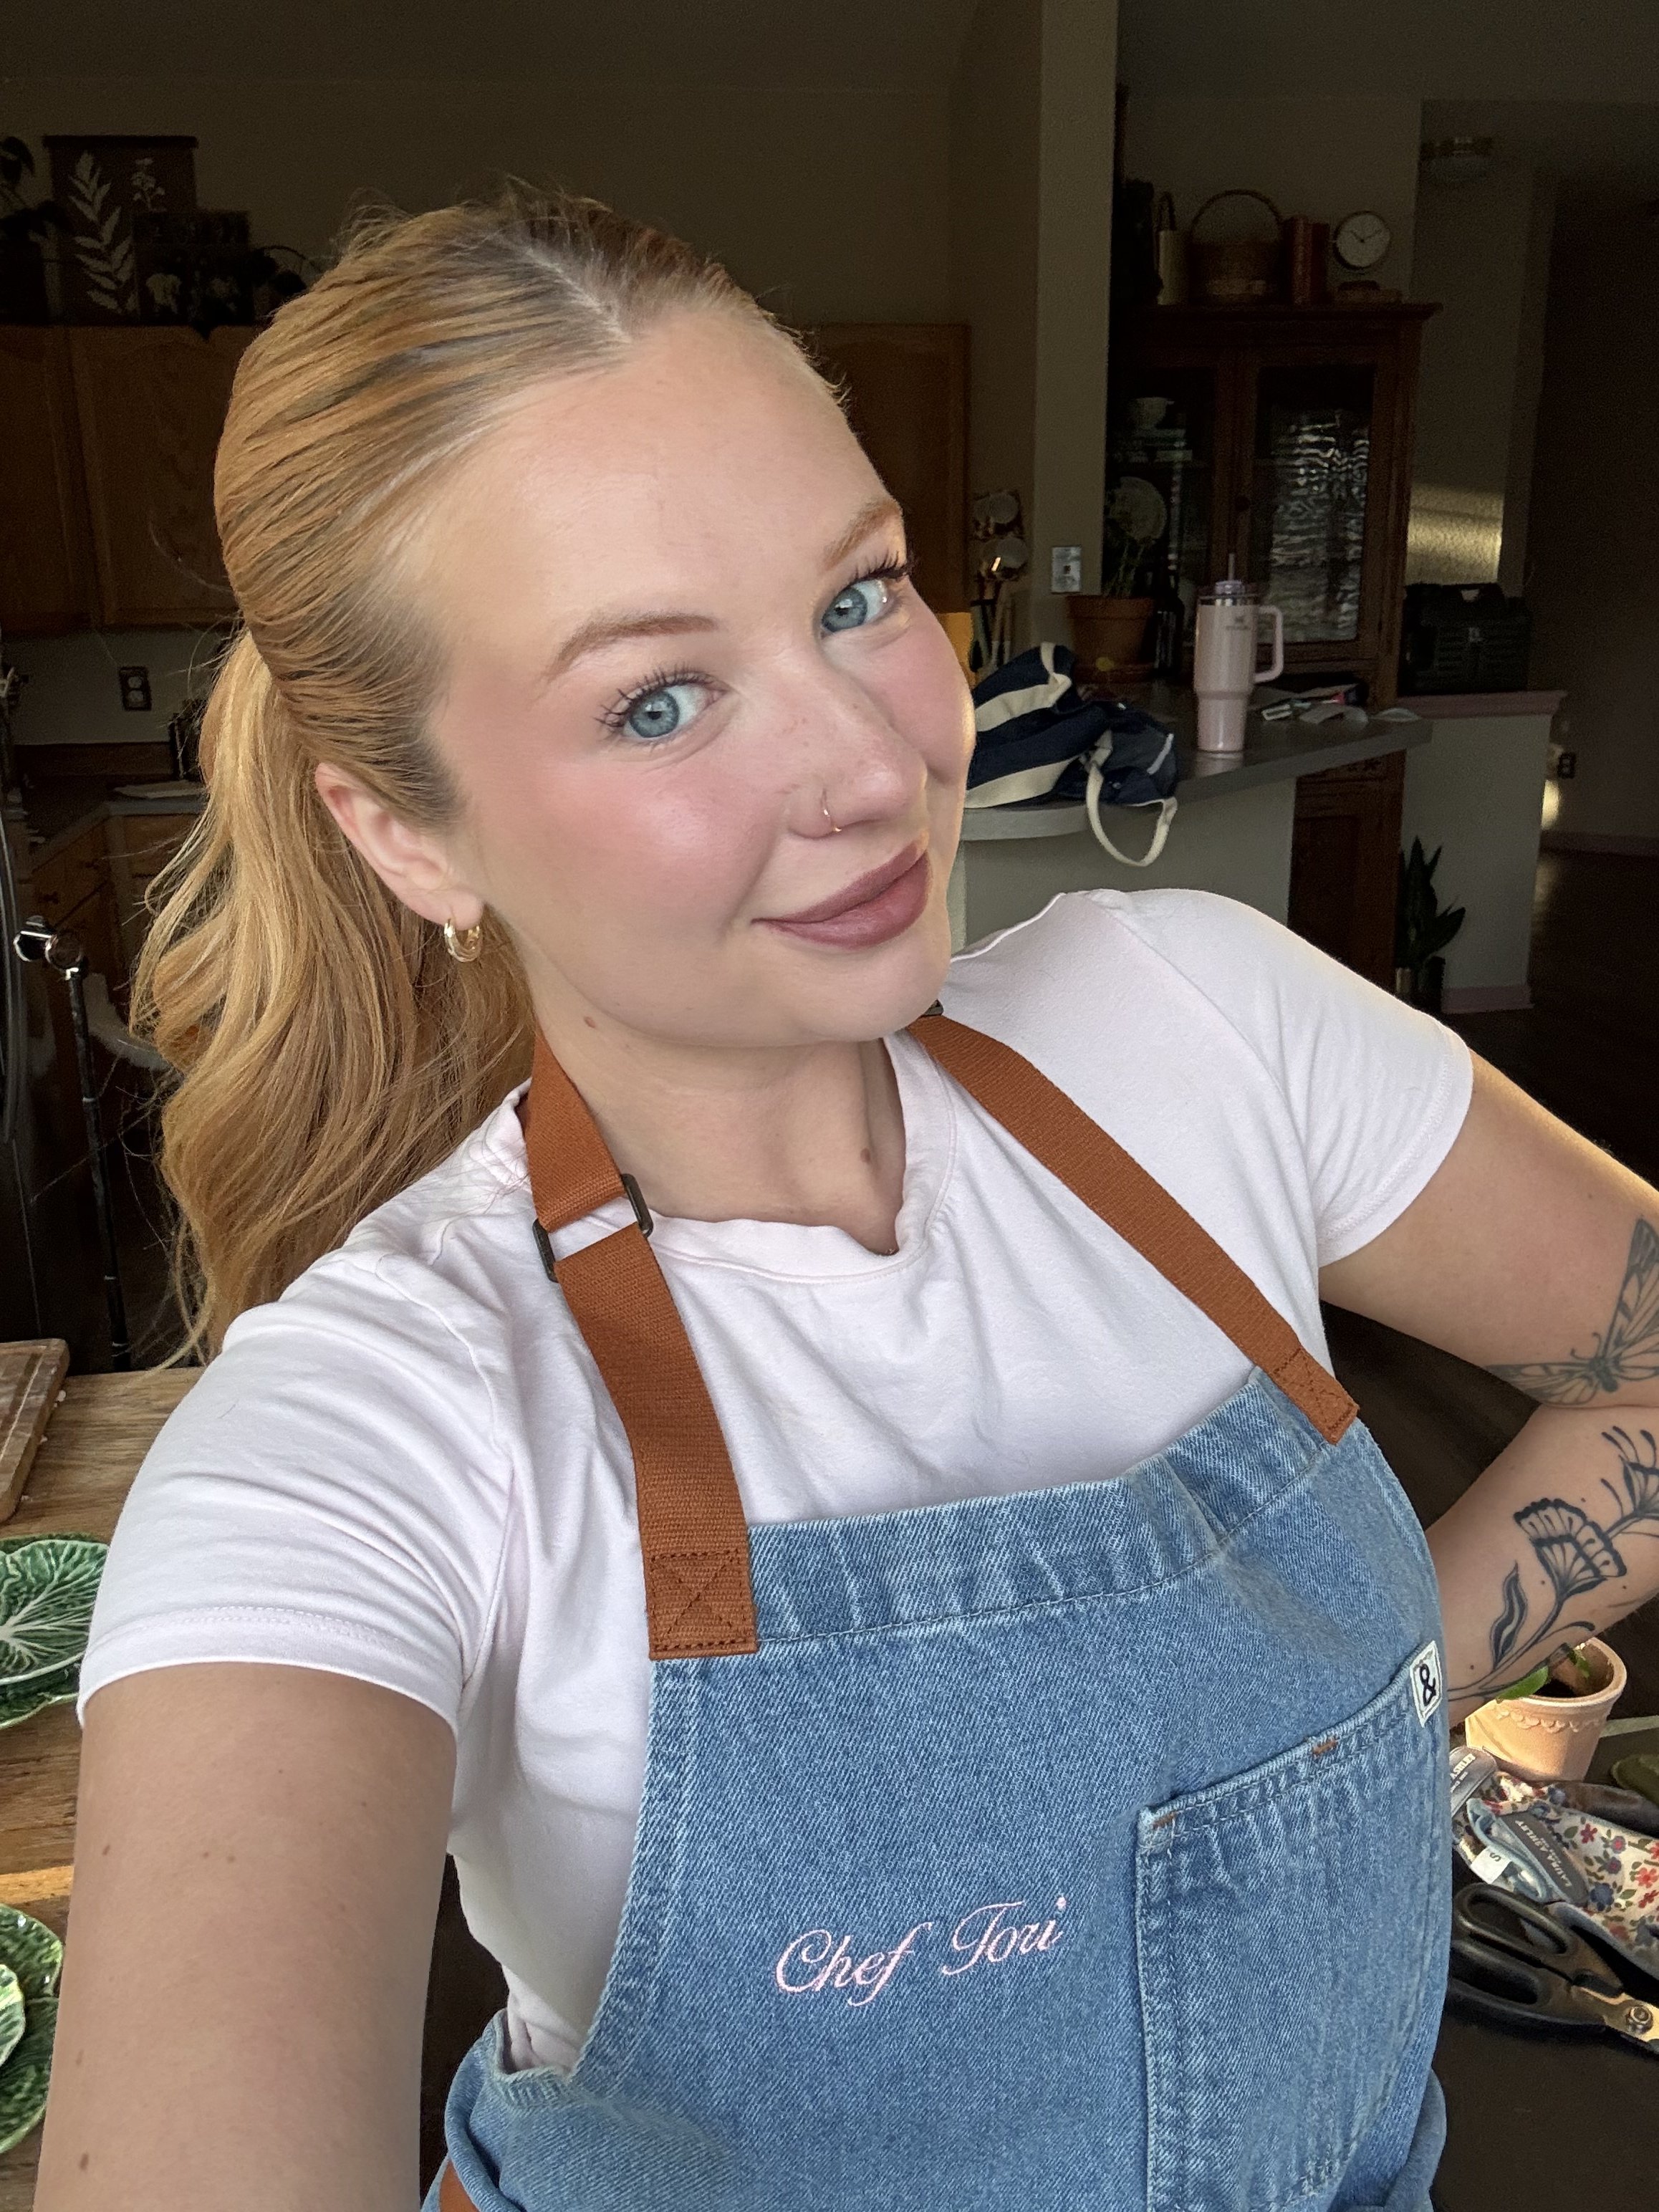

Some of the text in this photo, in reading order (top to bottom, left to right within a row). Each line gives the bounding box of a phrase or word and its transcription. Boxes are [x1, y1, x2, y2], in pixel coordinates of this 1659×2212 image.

[1420, 1663, 1436, 1706] &
[1515, 1820, 1548, 1852] ASHLEY
[1489, 1852, 1501, 1862] S
[1547, 1854, 1572, 1887] LAURA
[776, 1897, 1067, 2006] Chef Tori
